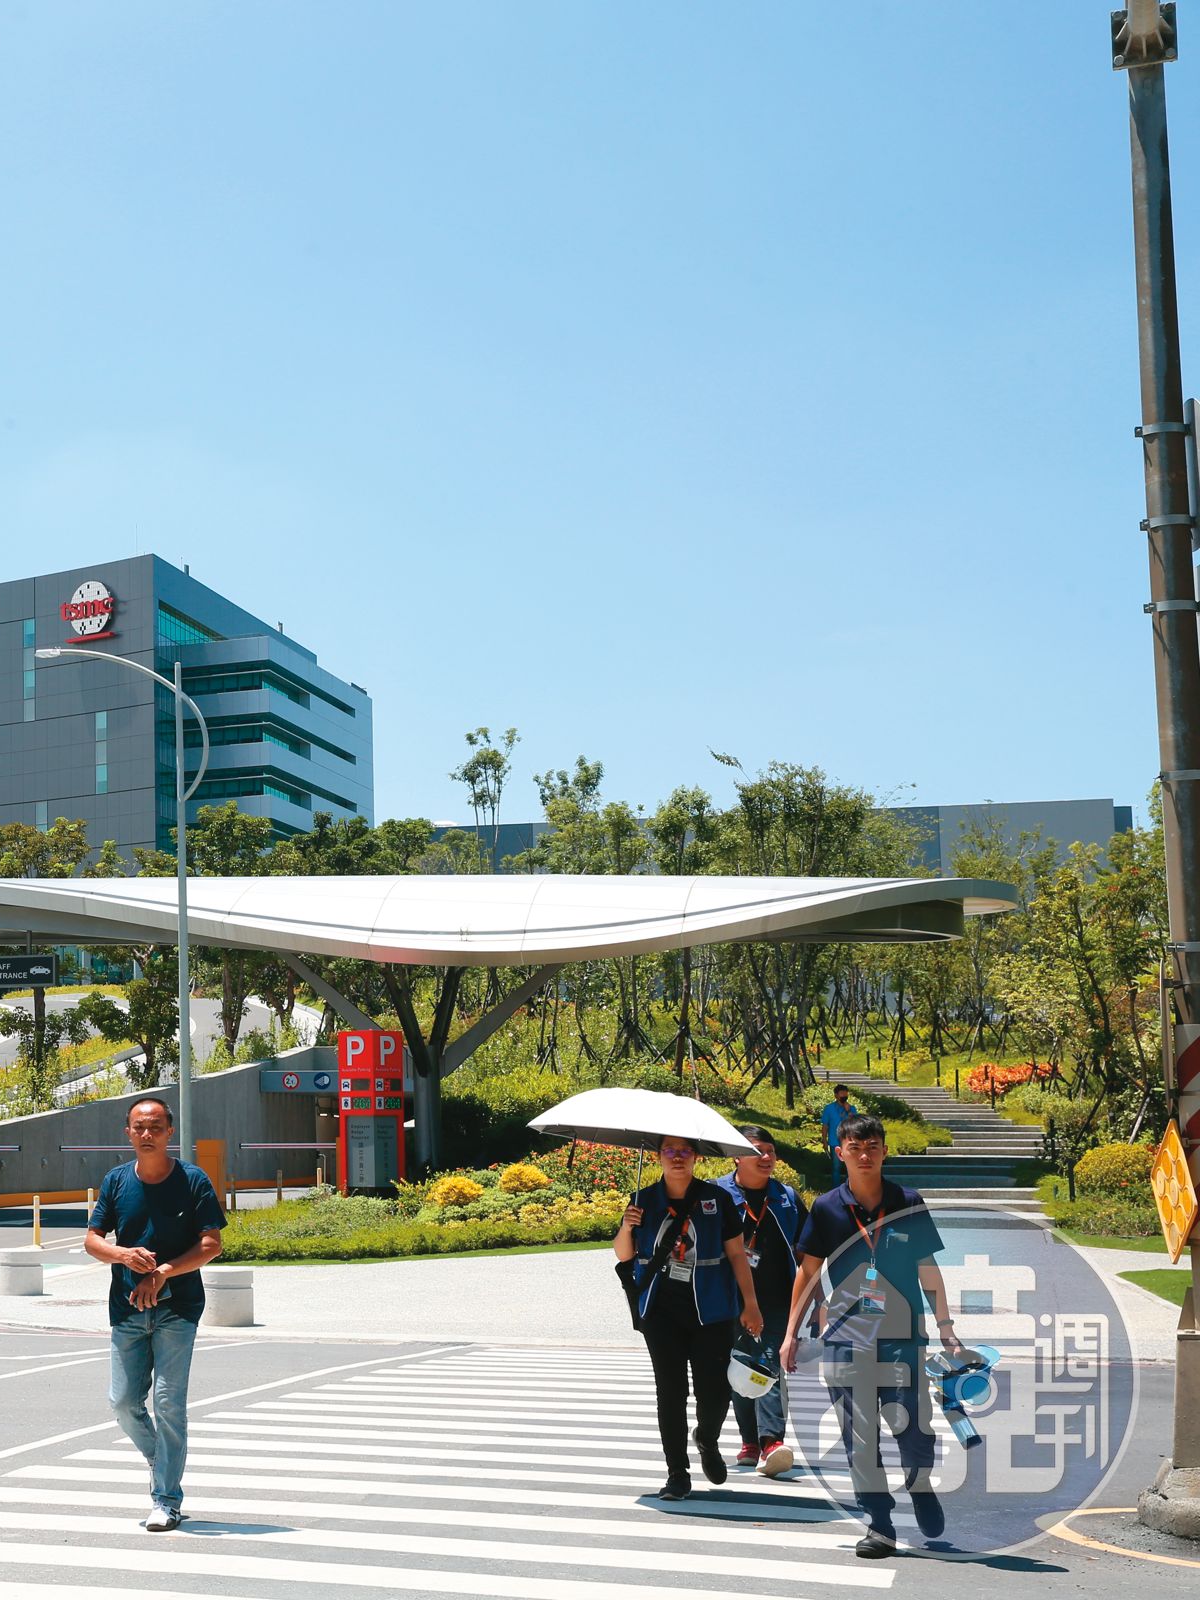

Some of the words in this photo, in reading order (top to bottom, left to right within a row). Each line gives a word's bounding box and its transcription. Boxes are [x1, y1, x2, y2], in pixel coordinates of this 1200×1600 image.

[60, 597, 114, 621] tsmc
[346, 1036, 364, 1066] P
[380, 1036, 396, 1066] P
